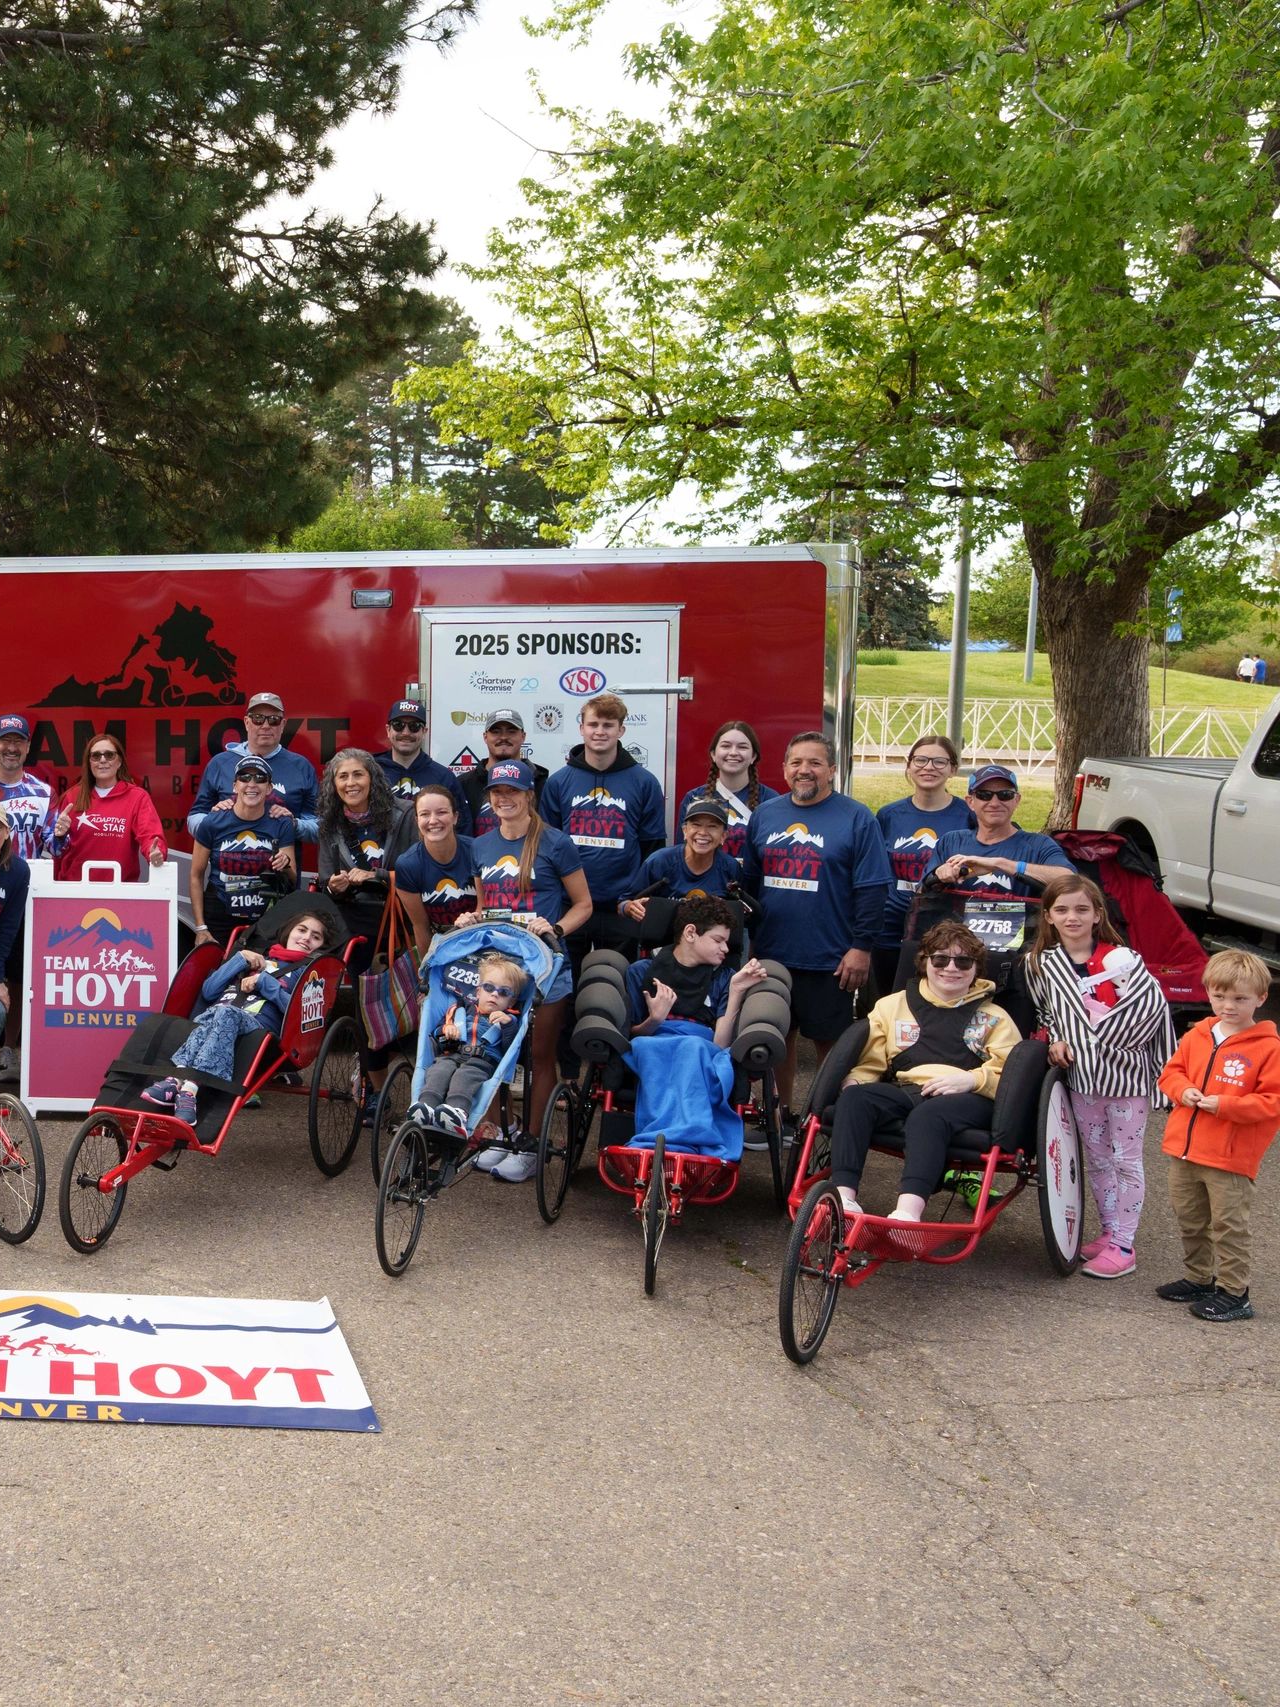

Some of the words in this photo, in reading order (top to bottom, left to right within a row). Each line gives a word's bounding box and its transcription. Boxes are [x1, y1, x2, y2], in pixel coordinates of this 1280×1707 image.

[455, 634, 509, 655] 2025
[517, 633, 641, 654] SPONSORS:
[477, 678, 516, 687] Chartway
[565, 670, 600, 692] YSC
[400, 702, 419, 711] HOYT
[467, 712, 489, 722] Nobl
[1086, 774, 1111, 789] FX4
[7, 812, 39, 833] OYT
[91, 816, 126, 824] ADAPTIVE
[103, 824, 126, 832] STAR
[570, 817, 625, 839] HOYT
[578, 838, 616, 846] DENVER
[763, 857, 822, 879] HOYT
[968, 919, 1012, 934] 22758
[43, 956, 89, 970] TEAM
[448, 966, 480, 987] 2233
[45, 973, 158, 1007] HOYT
[302, 1001, 323, 1021] HOYT
[63, 1012, 137, 1026] DENVER
[1215, 1075, 1243, 1087] TIGERS
[48, 1361, 335, 1404] HOYT
